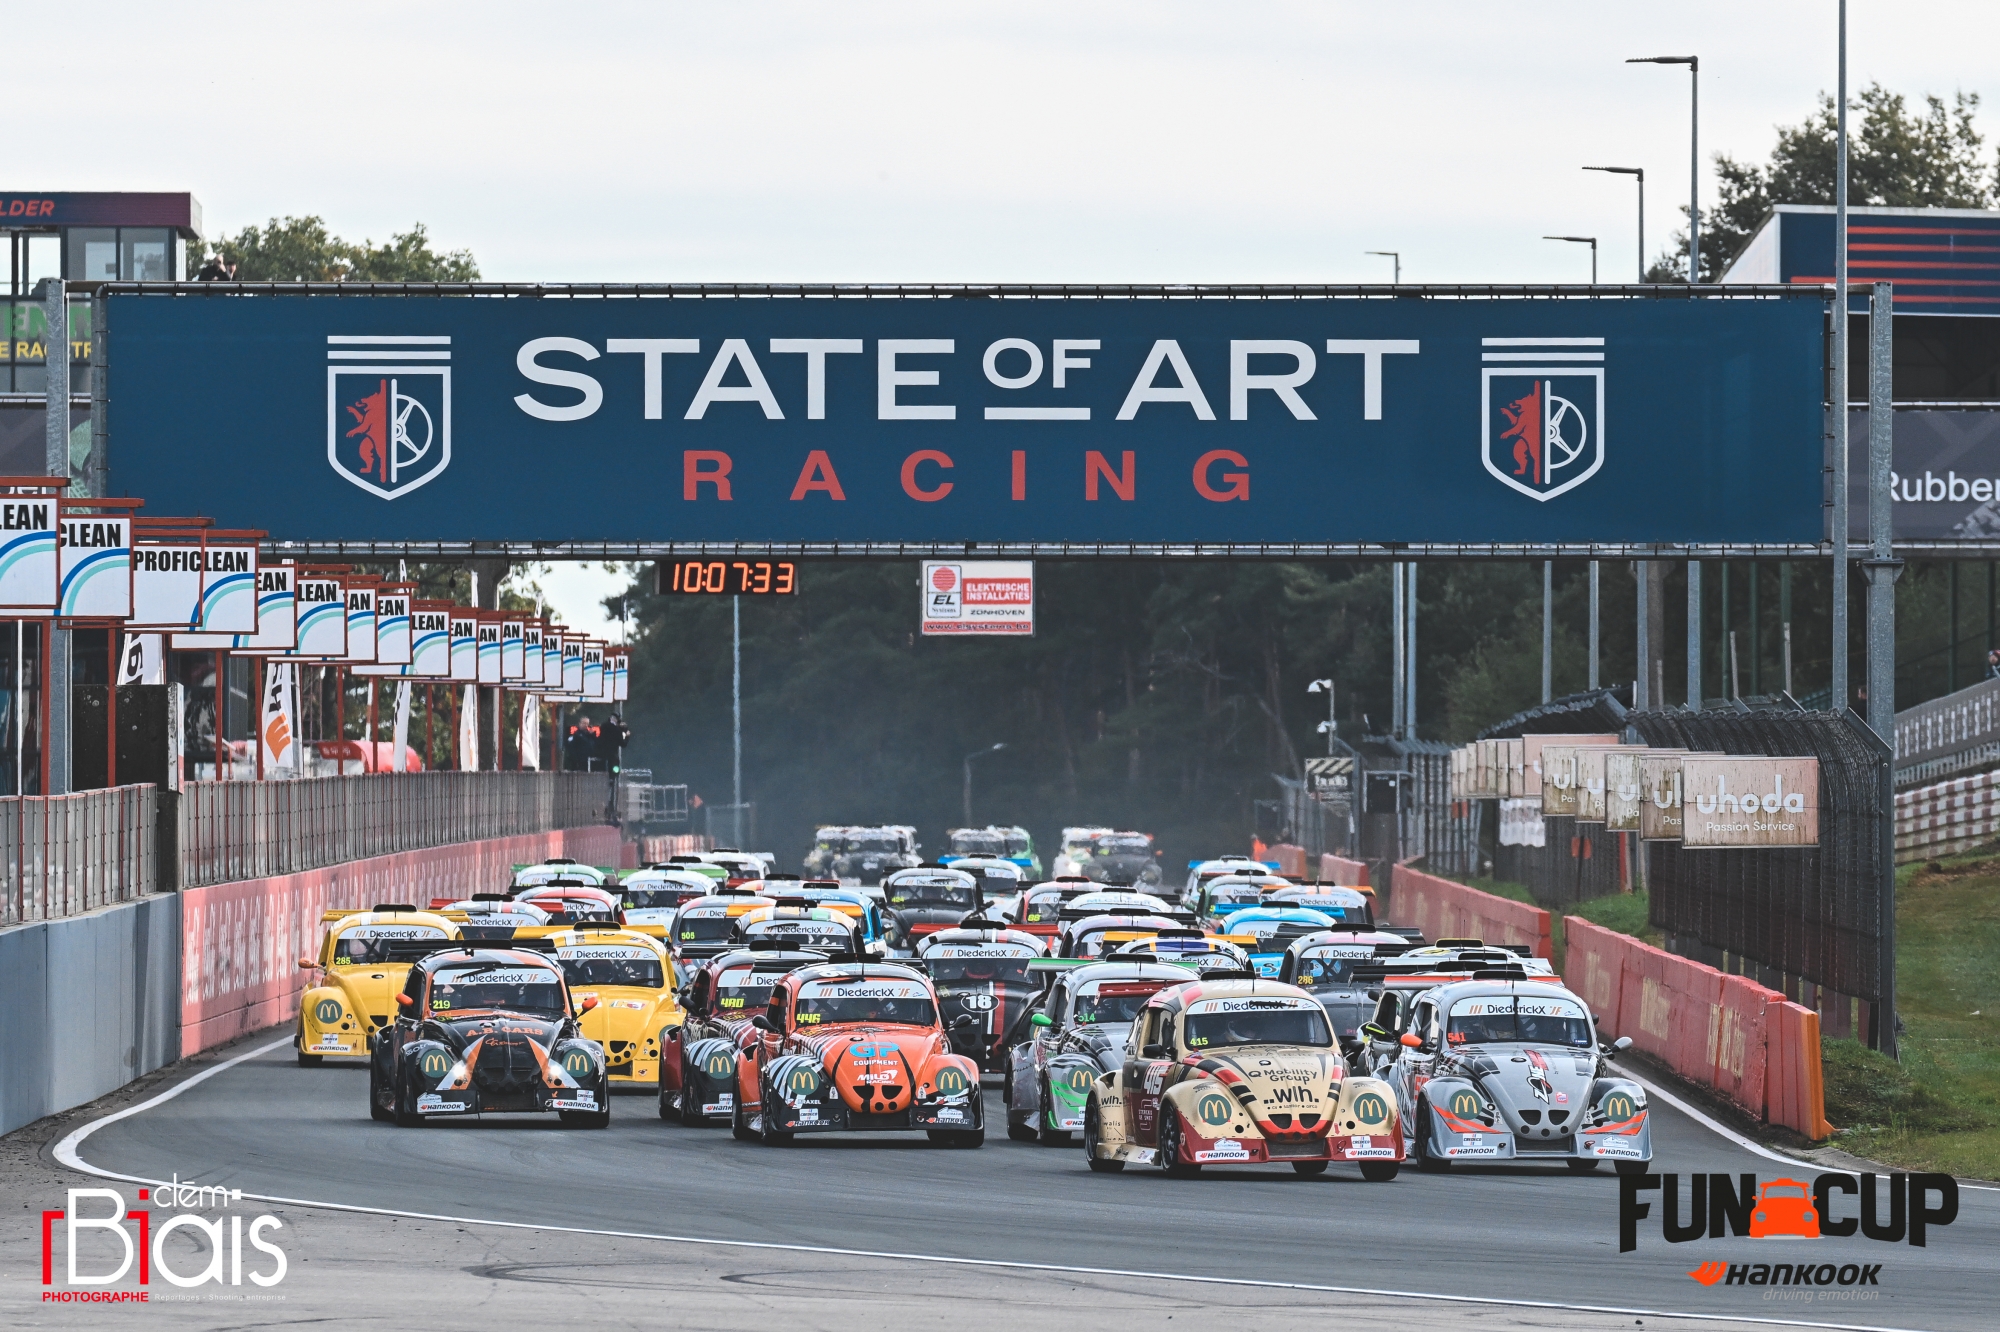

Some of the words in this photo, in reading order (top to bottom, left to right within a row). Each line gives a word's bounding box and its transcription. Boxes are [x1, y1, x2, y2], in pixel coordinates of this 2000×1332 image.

[514, 337, 956, 421] STATE
[982, 338, 1101, 388] OF
[1115, 338, 1419, 421] ART
[684, 449, 1250, 502] RACING
[0, 505, 47, 530] EAN
[966, 583, 1029, 592] ELEKTRISCHE
[966, 592, 1030, 601] INSTALLATIES
[1697, 774, 1804, 814] uhoda
[1706, 821, 1749, 832] Passion
[1753, 820, 1795, 832] Service
[576, 950, 627, 959] DiederickX
[957, 949, 1007, 957] DiederickX
[336, 957, 351, 965] 285
[468, 973, 523, 983] DiederickX
[837, 987, 894, 997] DiederickX
[433, 1000, 450, 1009] 219
[966, 994, 992, 1009] 18
[797, 1013, 821, 1023] 446
[501, 1027, 543, 1036] CARS
[1190, 1037, 1208, 1046] 415
[1447, 1032, 1466, 1042] 541
[849, 1042, 900, 1057] GP
[1264, 1067, 1317, 1080] Mobility
[1269, 1074, 1310, 1085] Group
